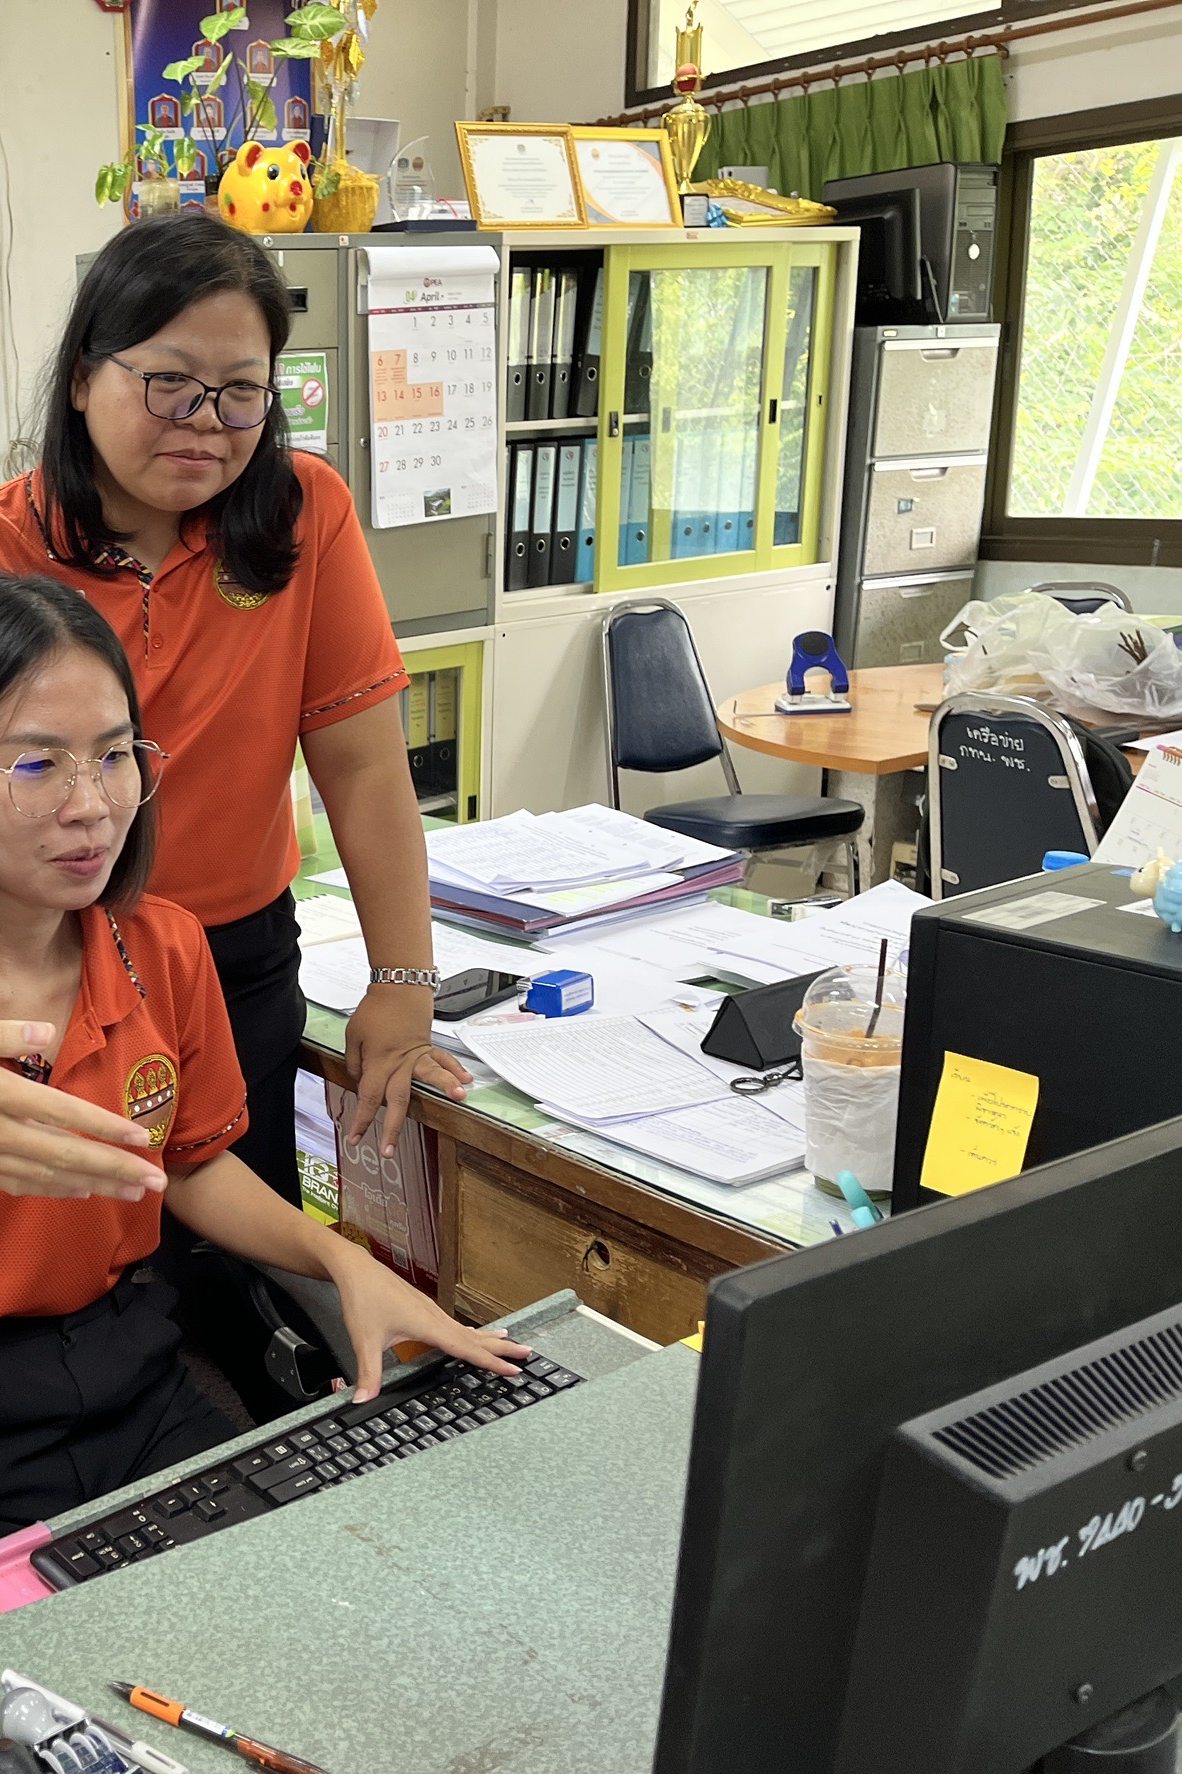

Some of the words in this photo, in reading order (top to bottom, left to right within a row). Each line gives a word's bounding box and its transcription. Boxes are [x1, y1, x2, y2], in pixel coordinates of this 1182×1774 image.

[420, 292, 440, 303] April
[447, 350, 456, 361] 10
[464, 348, 473, 359] 11
[481, 347, 492, 358] 12
[377, 391, 387, 402] 13
[394, 390, 404, 400] 14
[412, 388, 422, 399] 15
[430, 386, 440, 398] 16
[447, 385, 457, 395] 17
[464, 383, 474, 394] 18
[482, 382, 492, 392] 19
[378, 426, 388, 437] 20
[395, 425, 404, 436] 21
[412, 423, 423, 434] 22
[430, 421, 440, 432] 23
[447, 420, 458, 430] 24
[465, 418, 475, 429] 25
[482, 416, 493, 427] 26
[379, 461, 389, 473] 27
[396, 459, 406, 471] 28
[413, 457, 424, 469] 29
[430, 455, 441, 467] 30
[966, 726, 1024, 751] เครือข่าย
